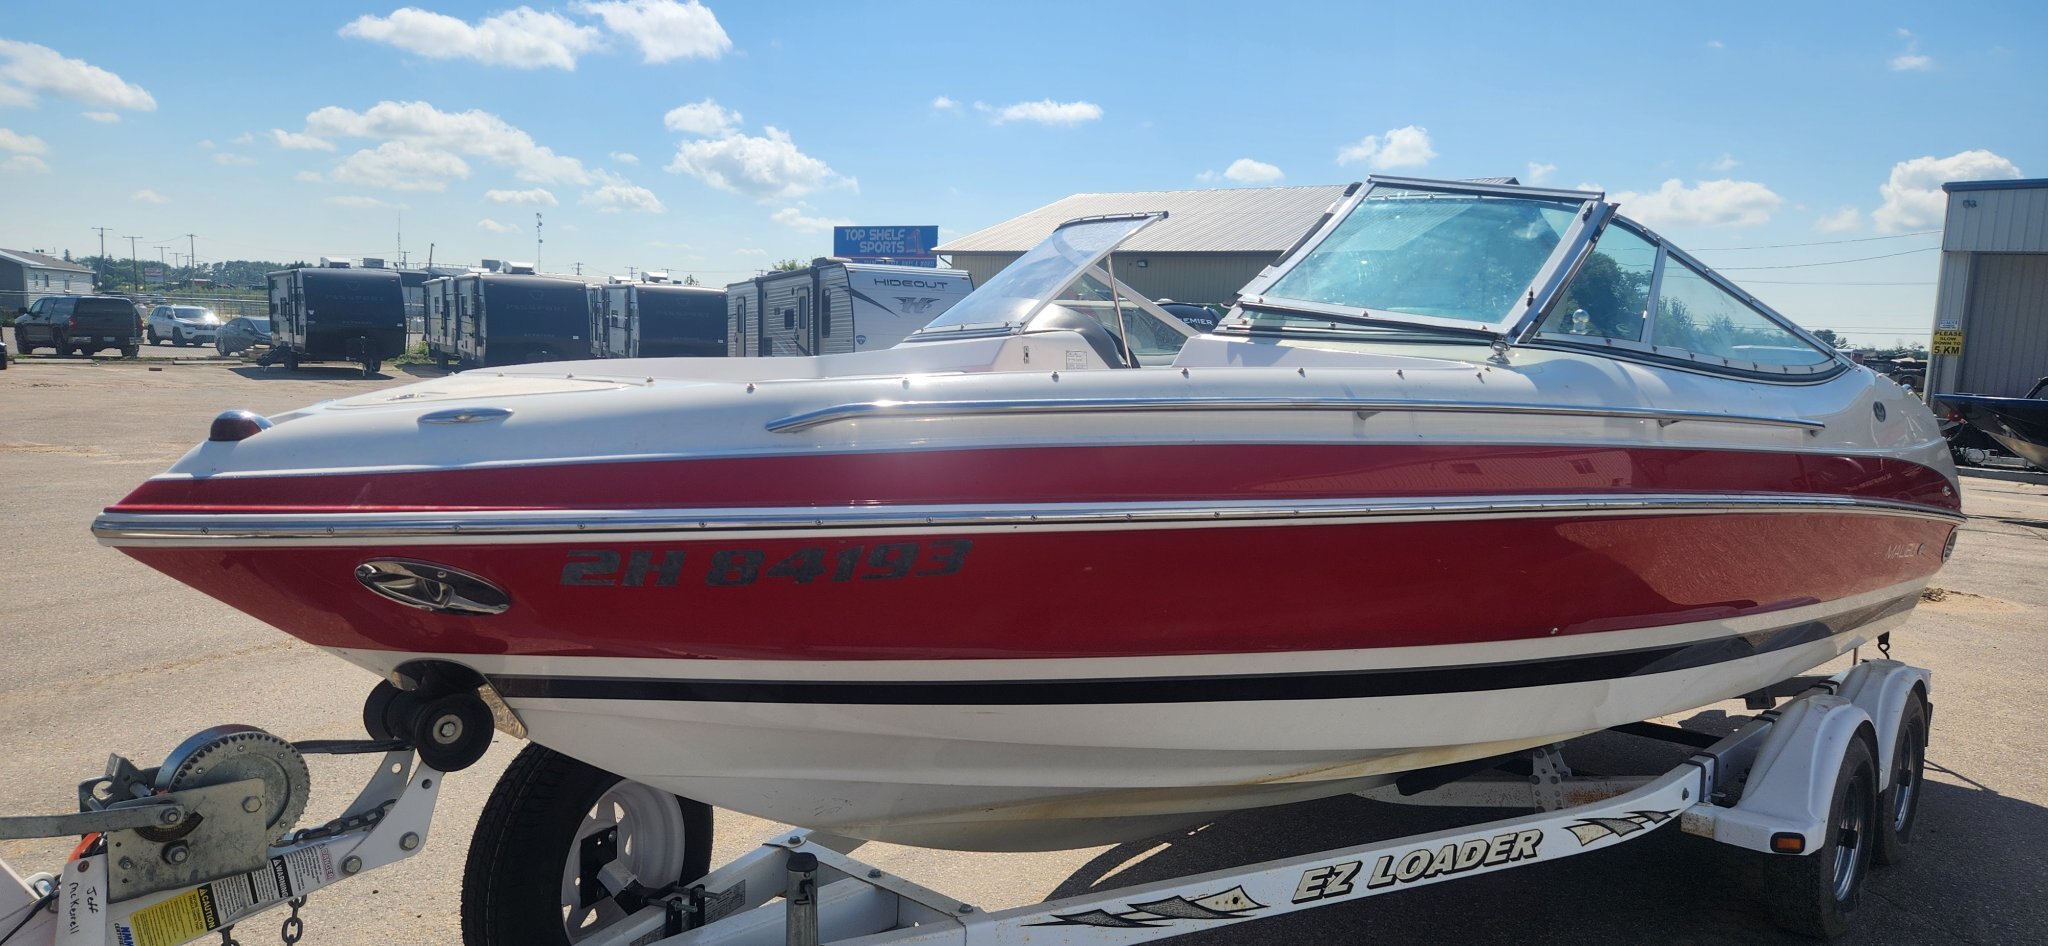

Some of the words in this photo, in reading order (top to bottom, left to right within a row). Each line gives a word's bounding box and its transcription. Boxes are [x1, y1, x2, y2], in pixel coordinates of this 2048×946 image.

[844, 229, 865, 240] TOP
[869, 229, 905, 240] SHELF
[859, 241, 905, 253] SPORTS
[873, 278, 948, 289] HIDEOUT
[1182, 317, 1213, 326] EMIER
[1934, 346, 1941, 354] 5
[1943, 346, 1960, 355] KM
[560, 549, 688, 588] 2H
[705, 539, 973, 586] 84193
[320, 850, 334, 880] DANGER
[1292, 860, 1362, 904] EZ
[1367, 828, 1544, 889] LOADER
[276, 864, 289, 897] WARNING
[201, 894, 216, 928] CAUTION
[120, 926, 134, 946] NMM
